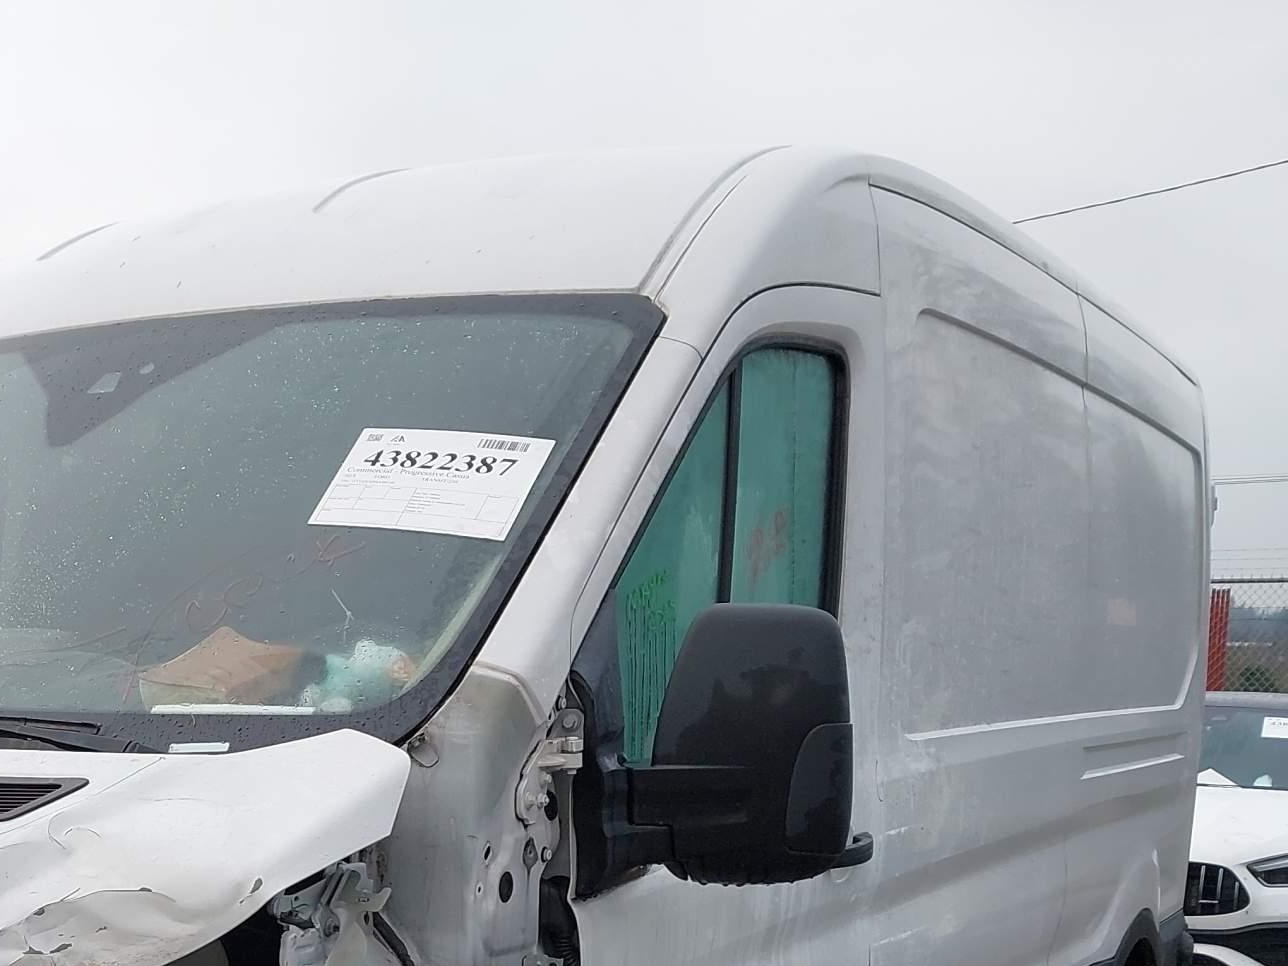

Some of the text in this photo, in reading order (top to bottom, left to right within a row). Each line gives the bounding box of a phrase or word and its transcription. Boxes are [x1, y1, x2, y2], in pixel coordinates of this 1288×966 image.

[347, 466, 393, 474] Commercial
[400, 468, 444, 477] Progressive
[364, 449, 519, 476] 43822387
